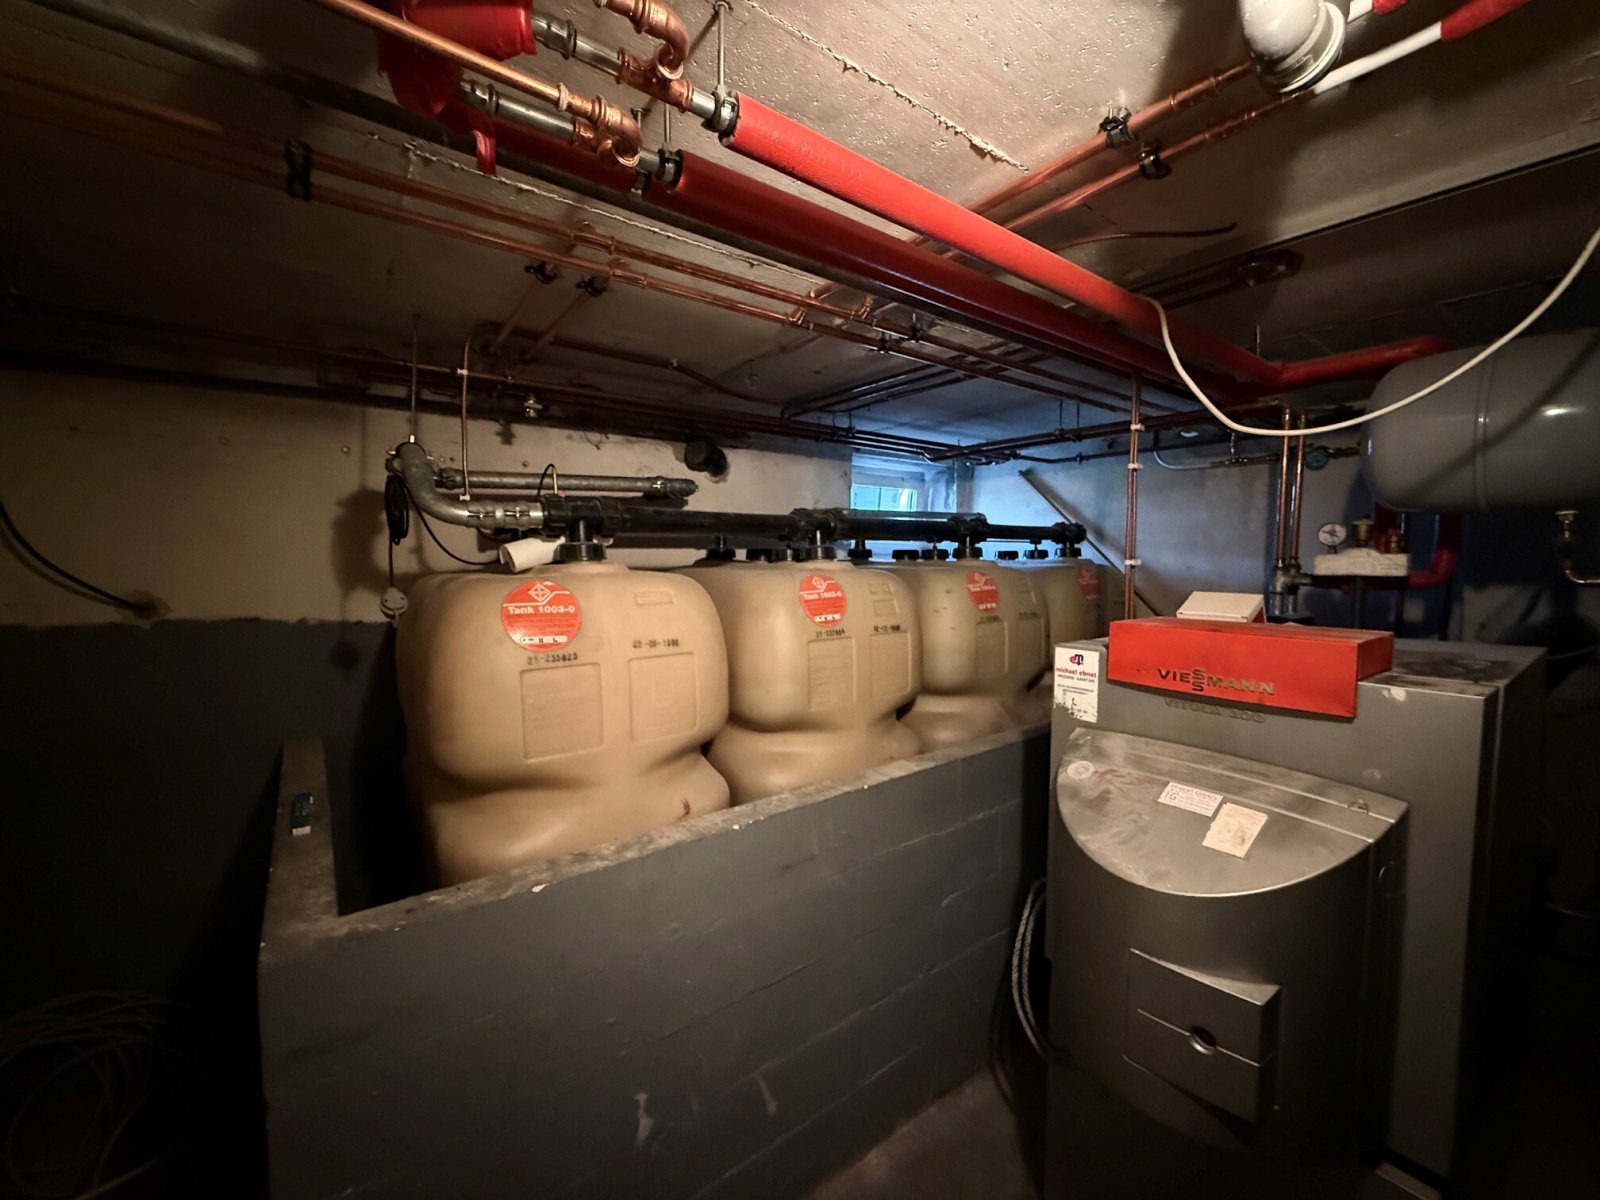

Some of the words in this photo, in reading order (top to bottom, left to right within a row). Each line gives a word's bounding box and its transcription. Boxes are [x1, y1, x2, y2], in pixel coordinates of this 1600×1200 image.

[507, 605, 535, 615] Tank
[538, 604, 576, 614] 1003-0
[1157, 666, 1276, 696] VIESSMANN
